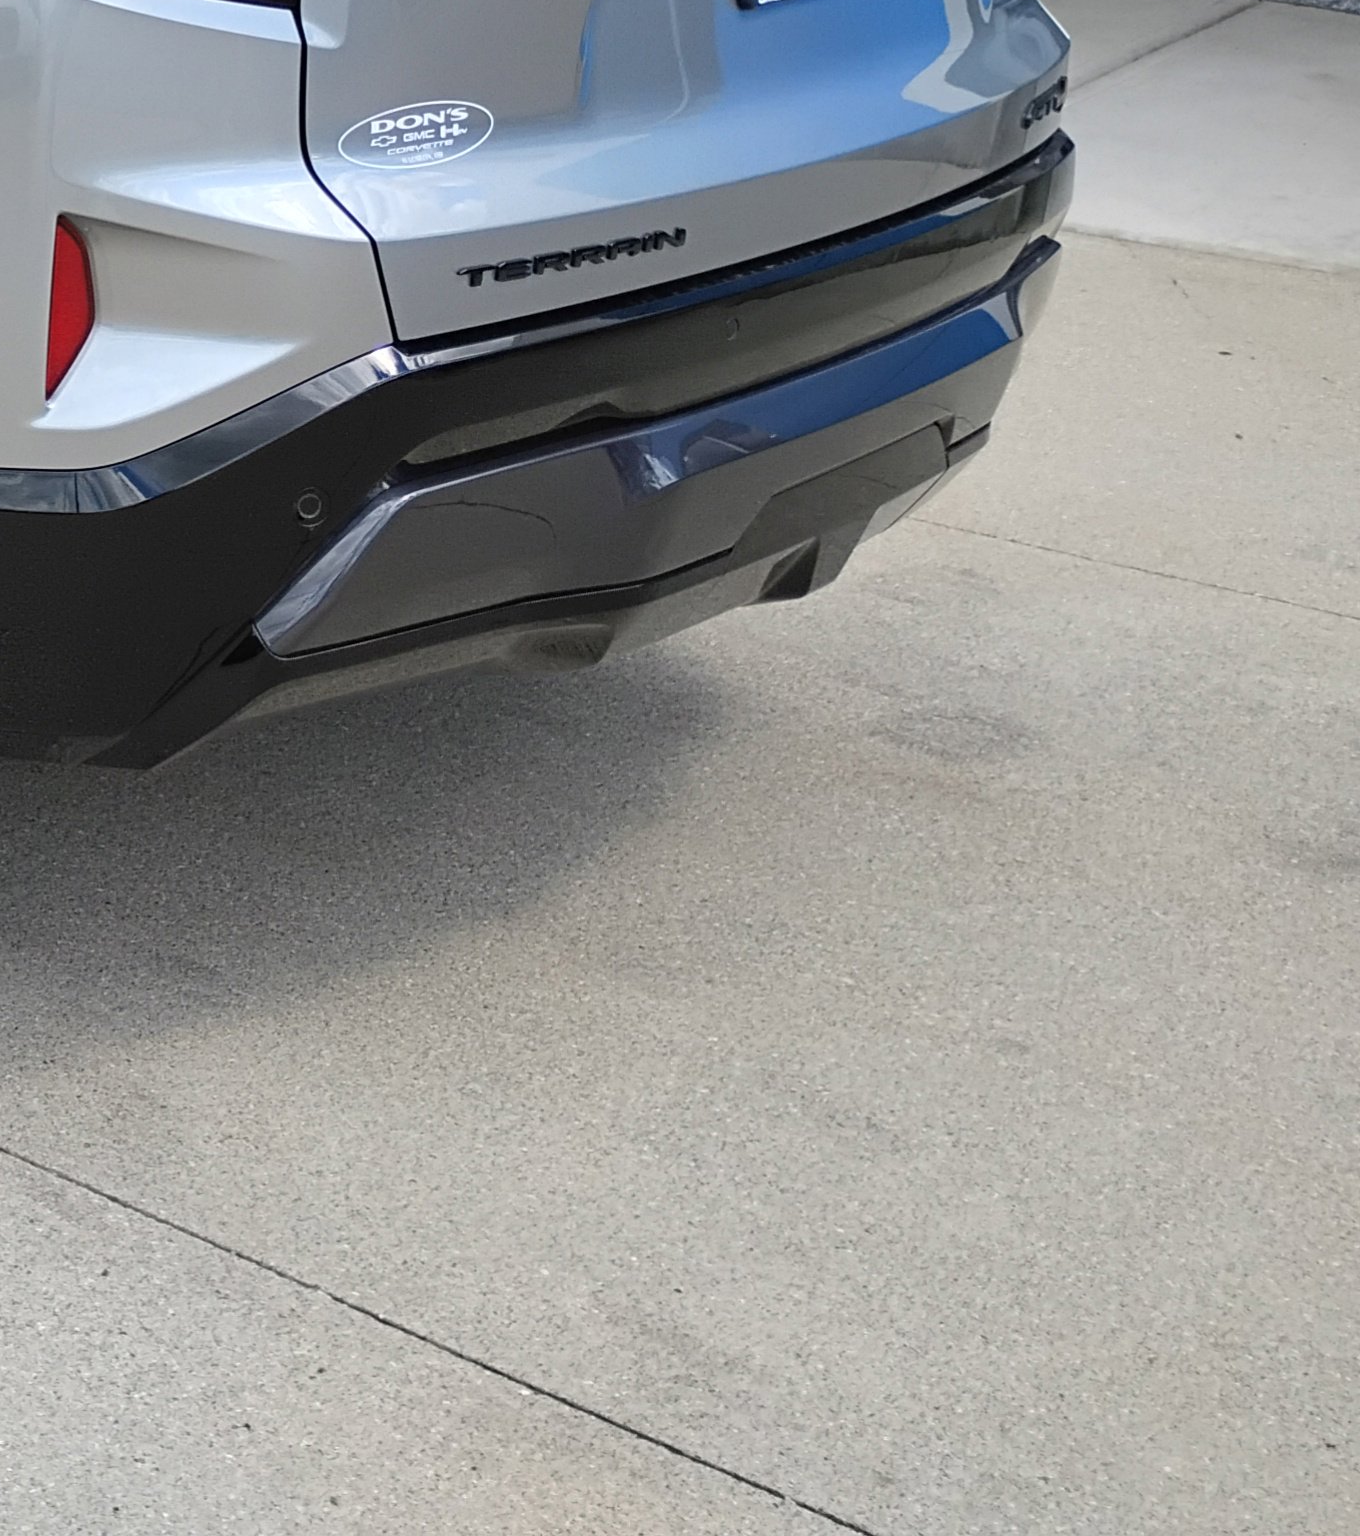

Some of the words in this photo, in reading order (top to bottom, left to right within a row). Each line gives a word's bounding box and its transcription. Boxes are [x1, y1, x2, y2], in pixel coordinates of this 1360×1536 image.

[371, 107, 469, 134] DON'S
[403, 129, 436, 143] GMC
[387, 139, 454, 156] CORVETTE
[456, 227, 687, 288] TERRAIN
